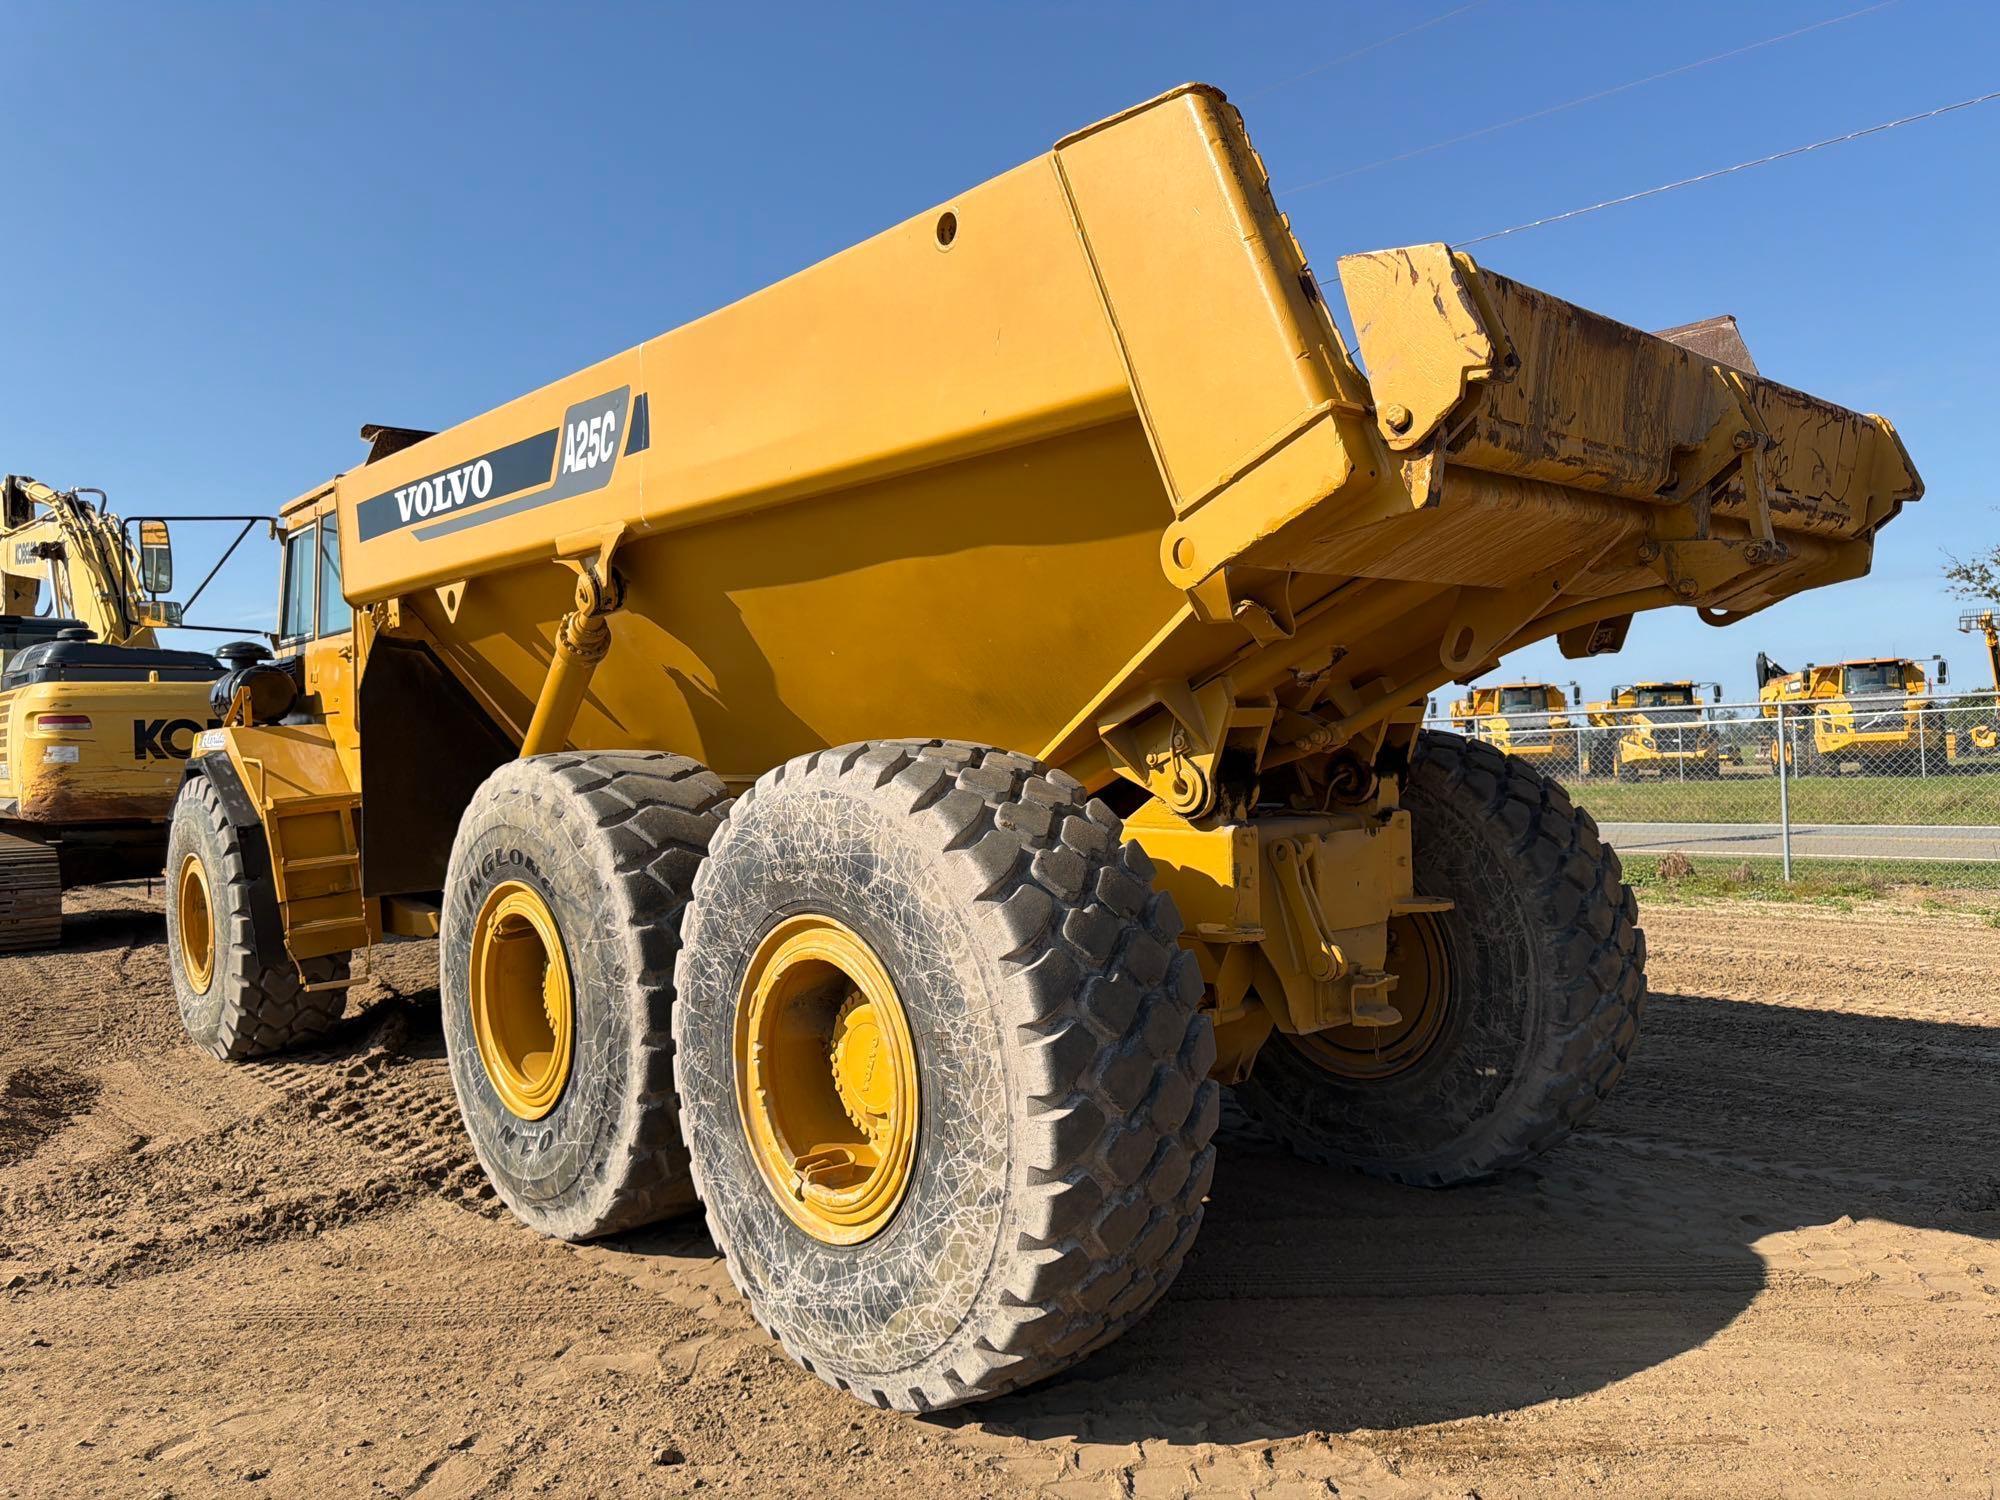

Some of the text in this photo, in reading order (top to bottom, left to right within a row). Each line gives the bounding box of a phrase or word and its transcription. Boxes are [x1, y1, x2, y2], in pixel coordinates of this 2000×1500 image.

[394, 410, 616, 522] VOLVO A25C
[134, 718, 225, 760] KO
